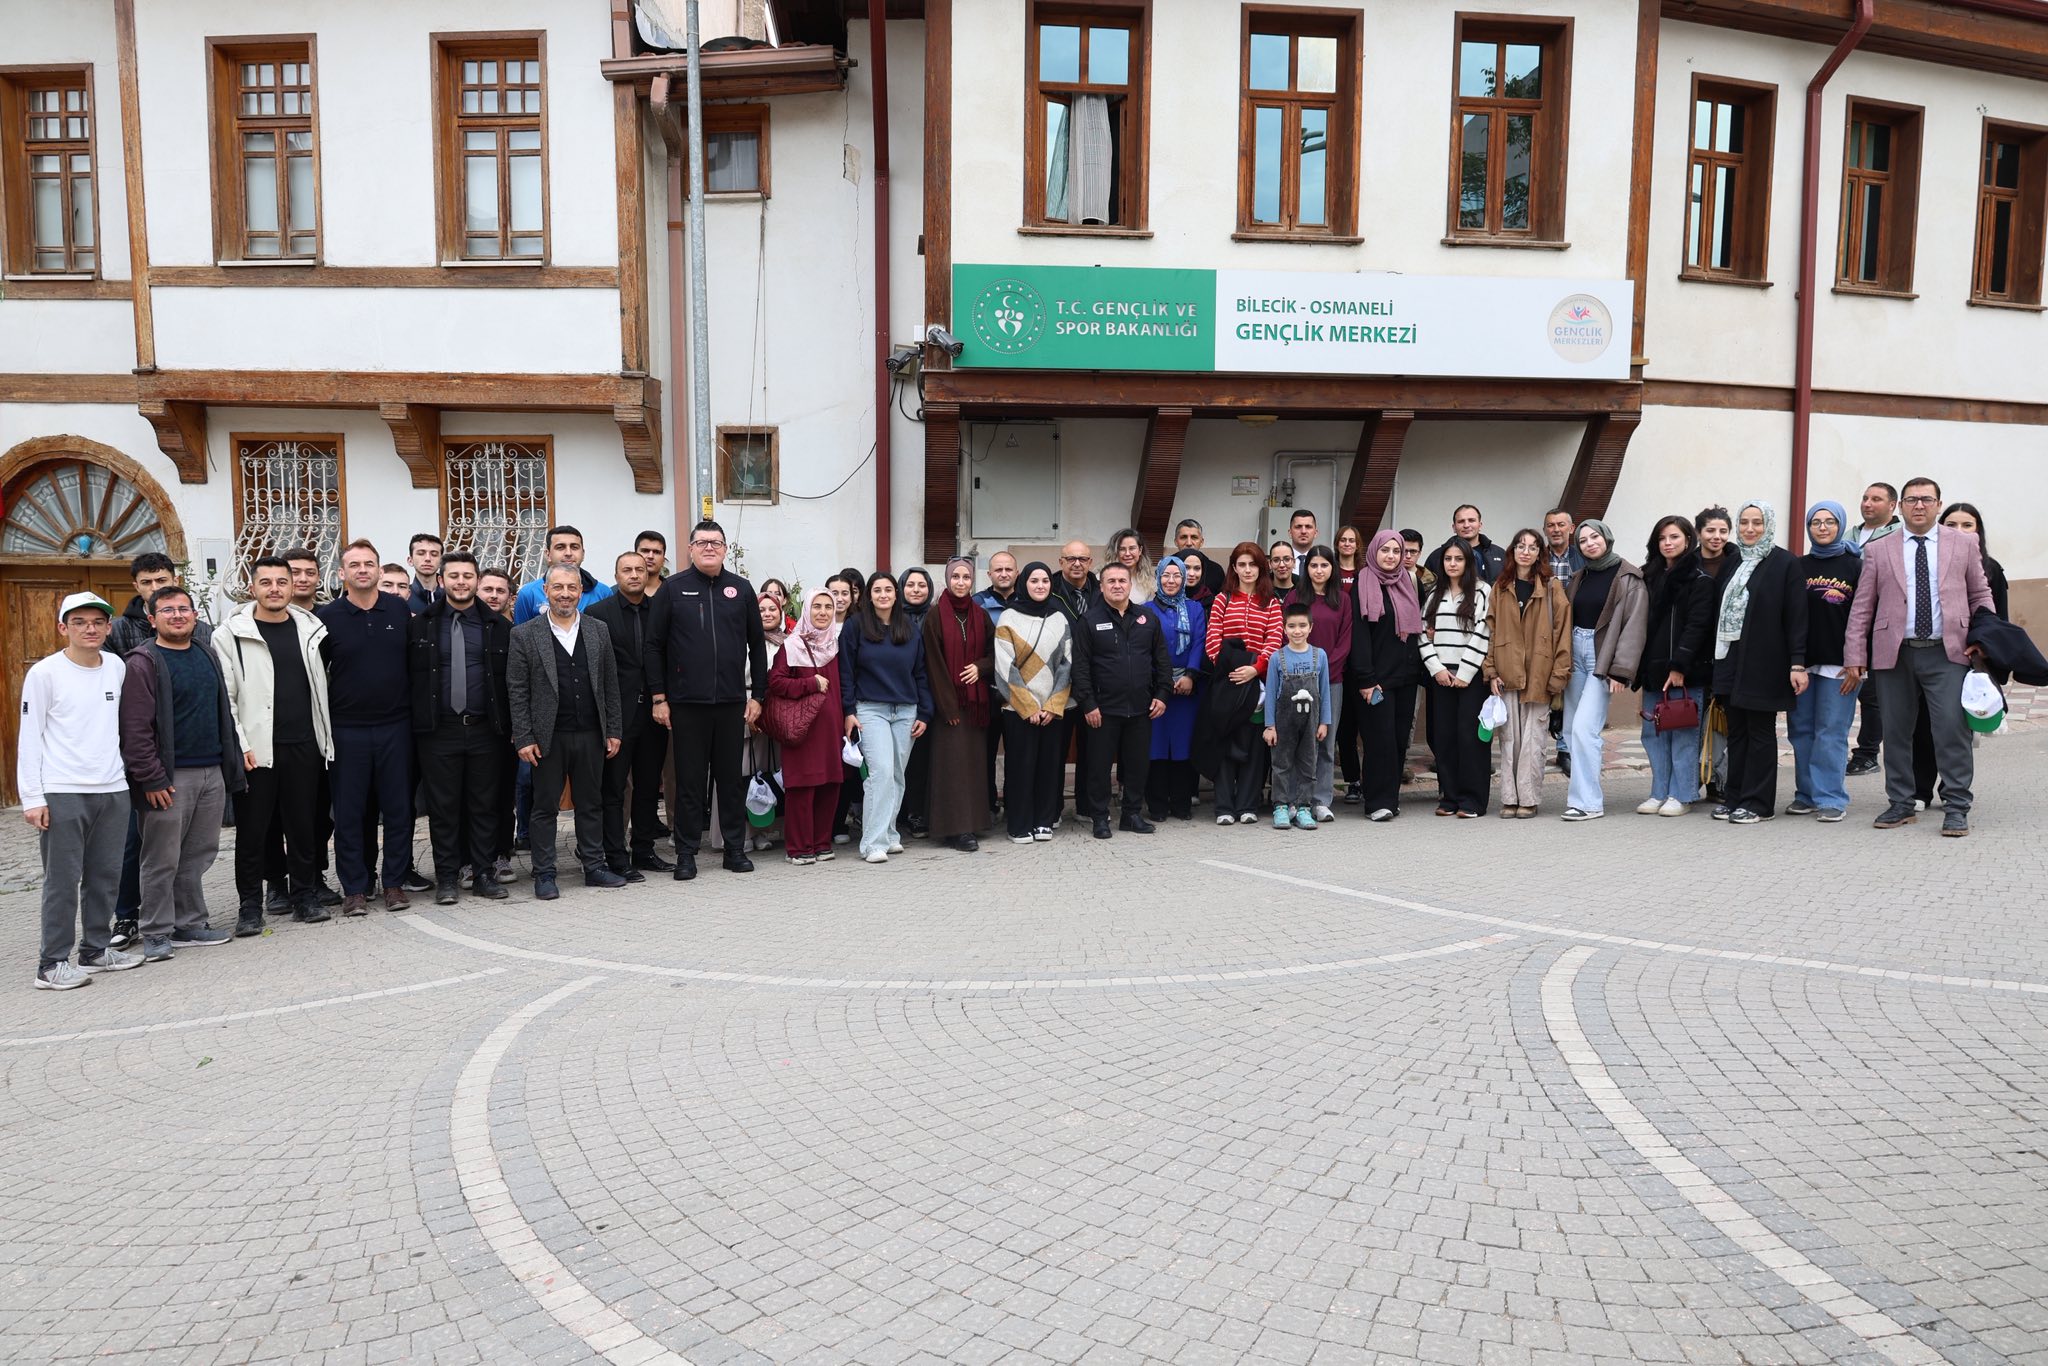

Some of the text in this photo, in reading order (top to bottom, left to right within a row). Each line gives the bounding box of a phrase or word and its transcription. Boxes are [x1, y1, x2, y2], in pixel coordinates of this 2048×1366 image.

[1056, 299, 1198, 320] T.C. GENÇLİK VE
[1236, 295, 1297, 314] BİLECİK
[1309, 299, 1393, 316] OSMANELİ
[1056, 320, 1198, 337] SPOR BAKANLIĞI
[1235, 320, 1417, 346] GENÇLİK MERKEZİ
